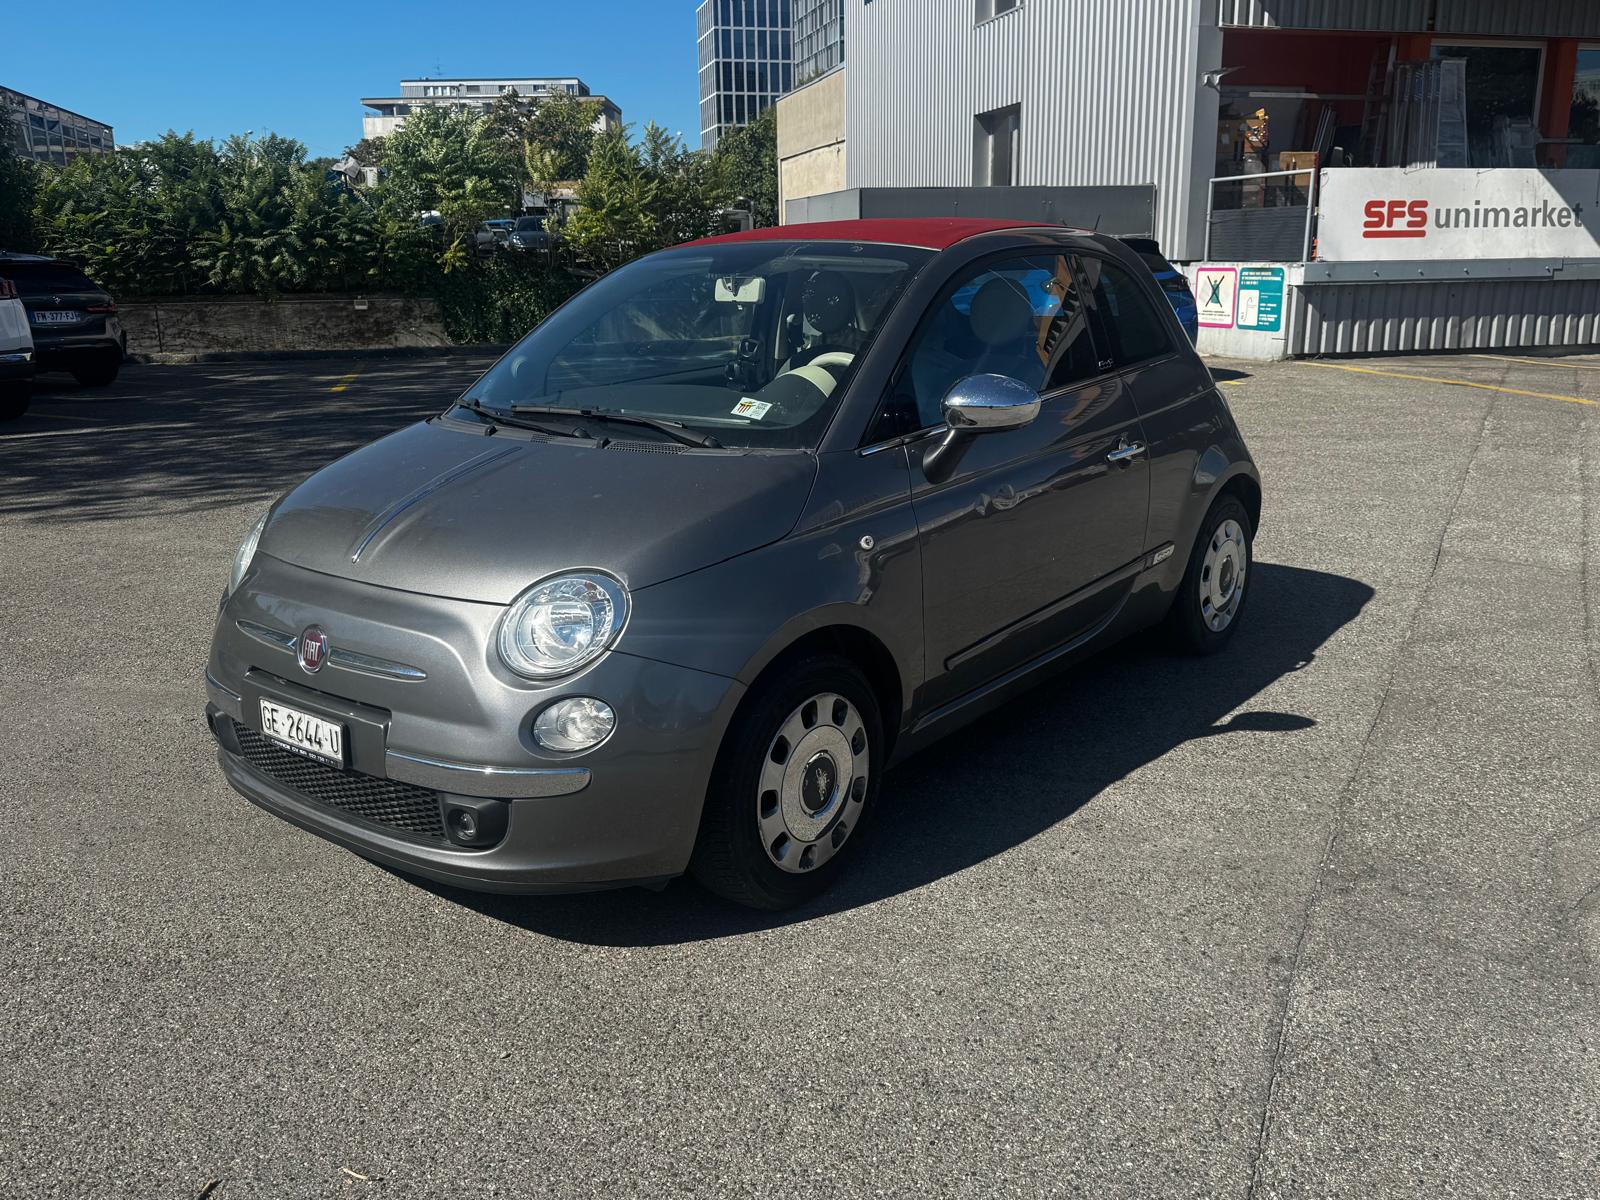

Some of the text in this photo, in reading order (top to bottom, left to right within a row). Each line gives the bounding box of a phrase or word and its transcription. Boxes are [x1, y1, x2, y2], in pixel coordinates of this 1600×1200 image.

[1363, 199, 1583, 229] SFS unimarket
[304, 639, 320, 661] FIAT
